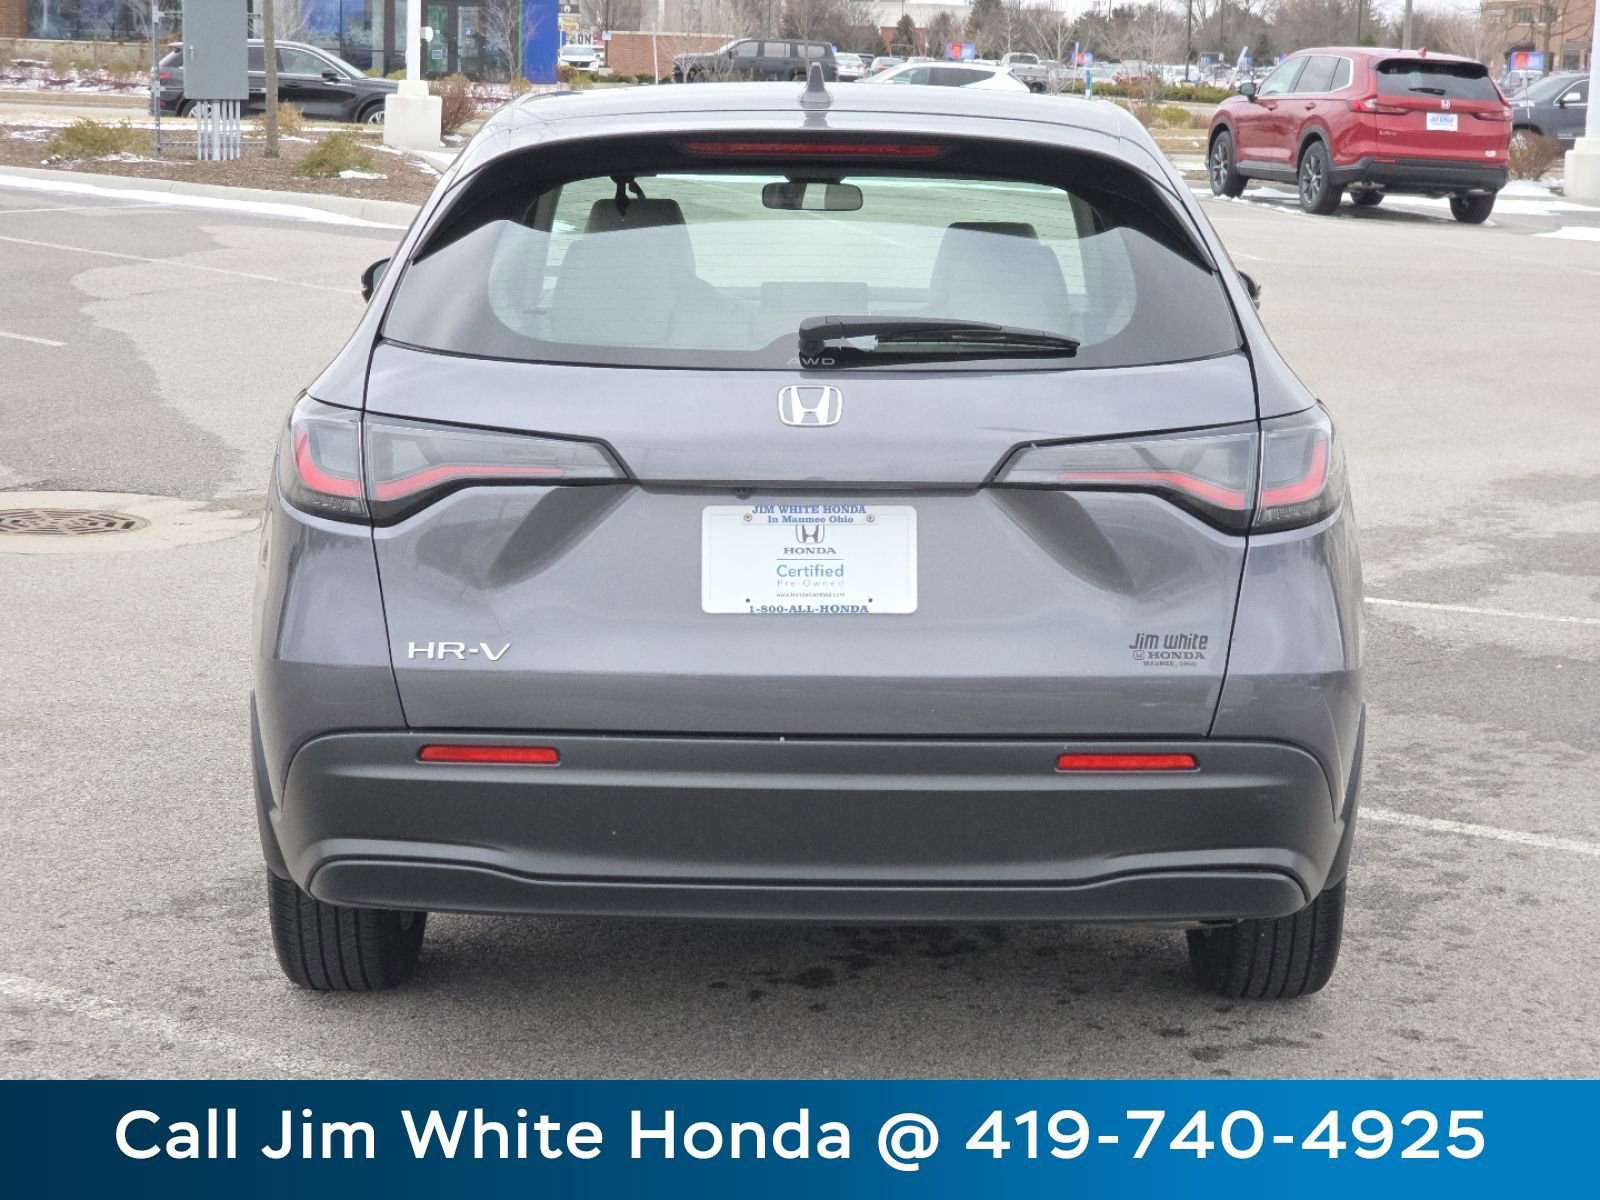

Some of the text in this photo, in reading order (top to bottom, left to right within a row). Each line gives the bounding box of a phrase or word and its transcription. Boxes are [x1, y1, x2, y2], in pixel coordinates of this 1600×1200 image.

[787, 357, 835, 365] AWD
[752, 505, 867, 514] JIM WHITE HONDA
[768, 515, 854, 523] In Maumee Ohio
[783, 547, 836, 555] HONDA
[776, 564, 844, 578] Certified
[777, 579, 844, 588] Pre-Owned
[749, 604, 869, 614] 1-800-ALL-HONDA
[1129, 633, 1160, 650] Jim
[408, 641, 511, 661] HR-V
[1148, 651, 1206, 660] HONDA
